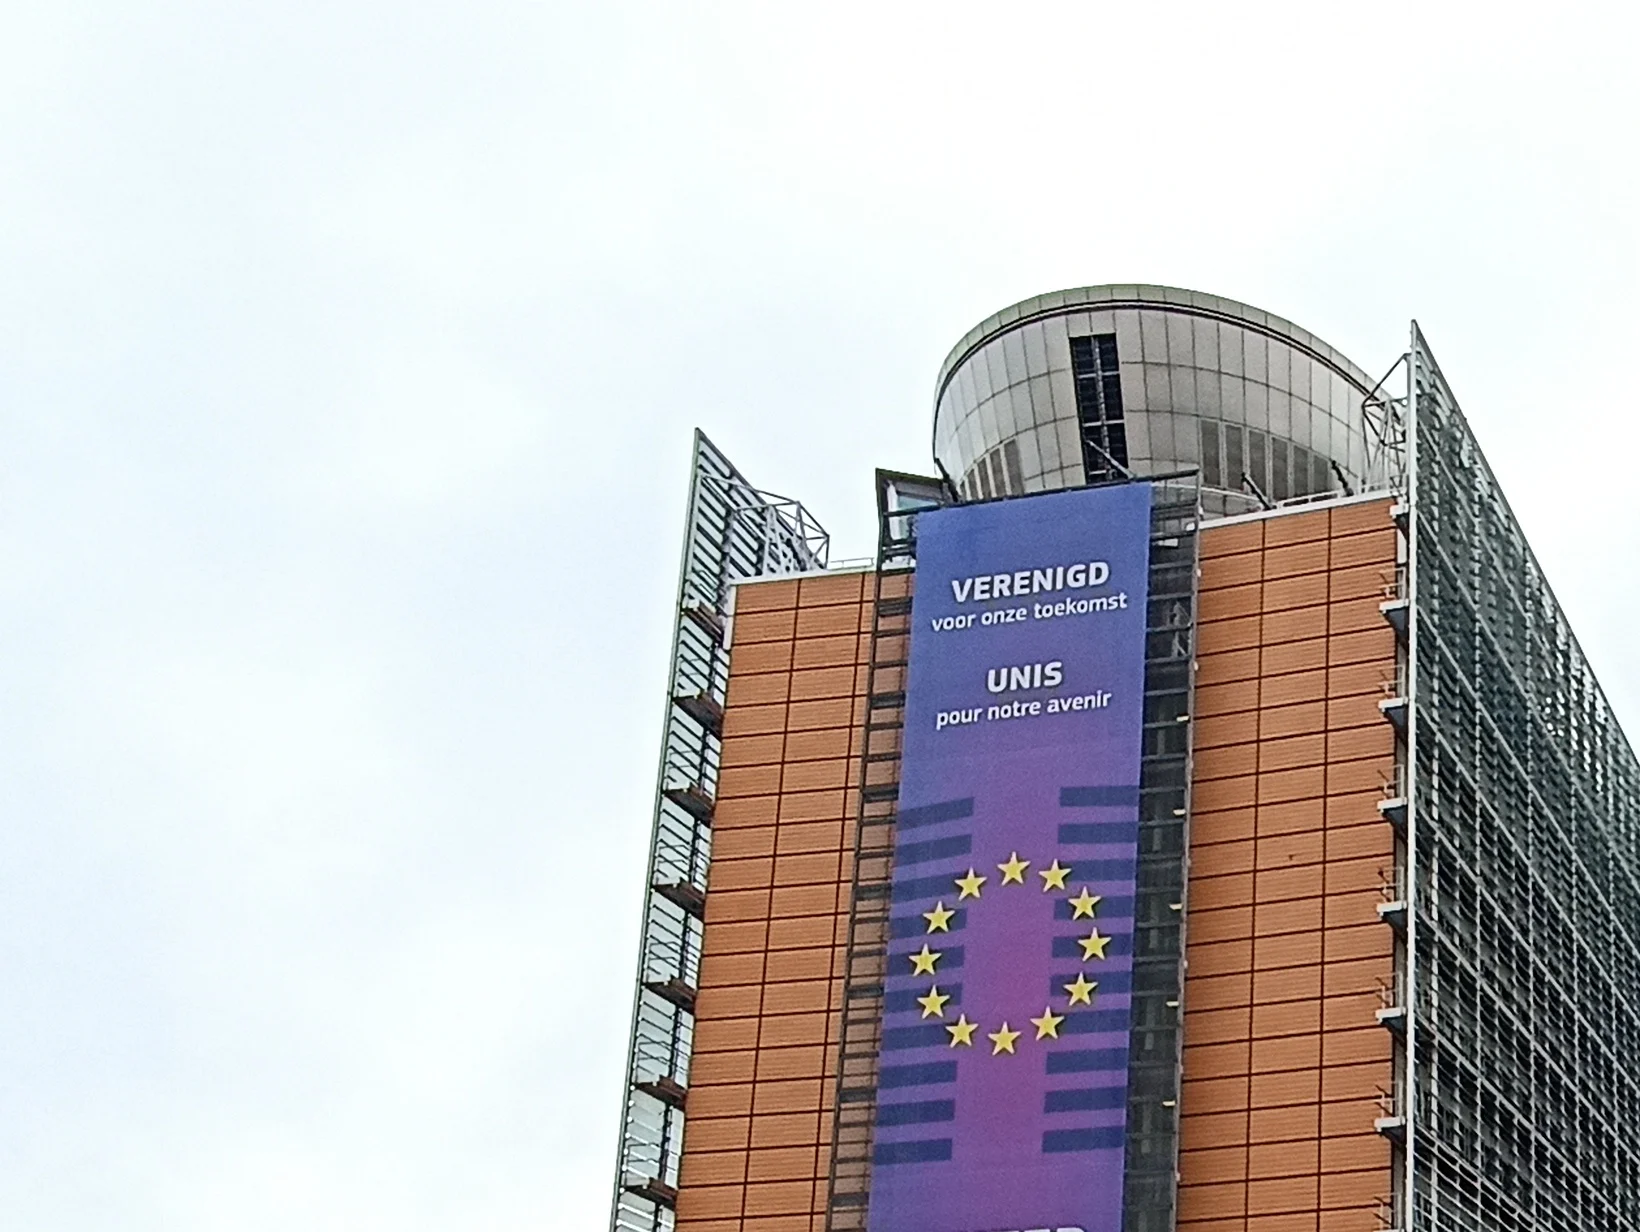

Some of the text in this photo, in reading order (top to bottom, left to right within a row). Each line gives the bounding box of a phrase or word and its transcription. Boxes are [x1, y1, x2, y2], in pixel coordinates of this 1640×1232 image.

[952, 562, 1110, 602] VERENIGD
[931, 592, 1127, 632] voor onze toekomst
[987, 662, 1063, 693] UNIS
[936, 690, 1112, 730] pour notre avenir
